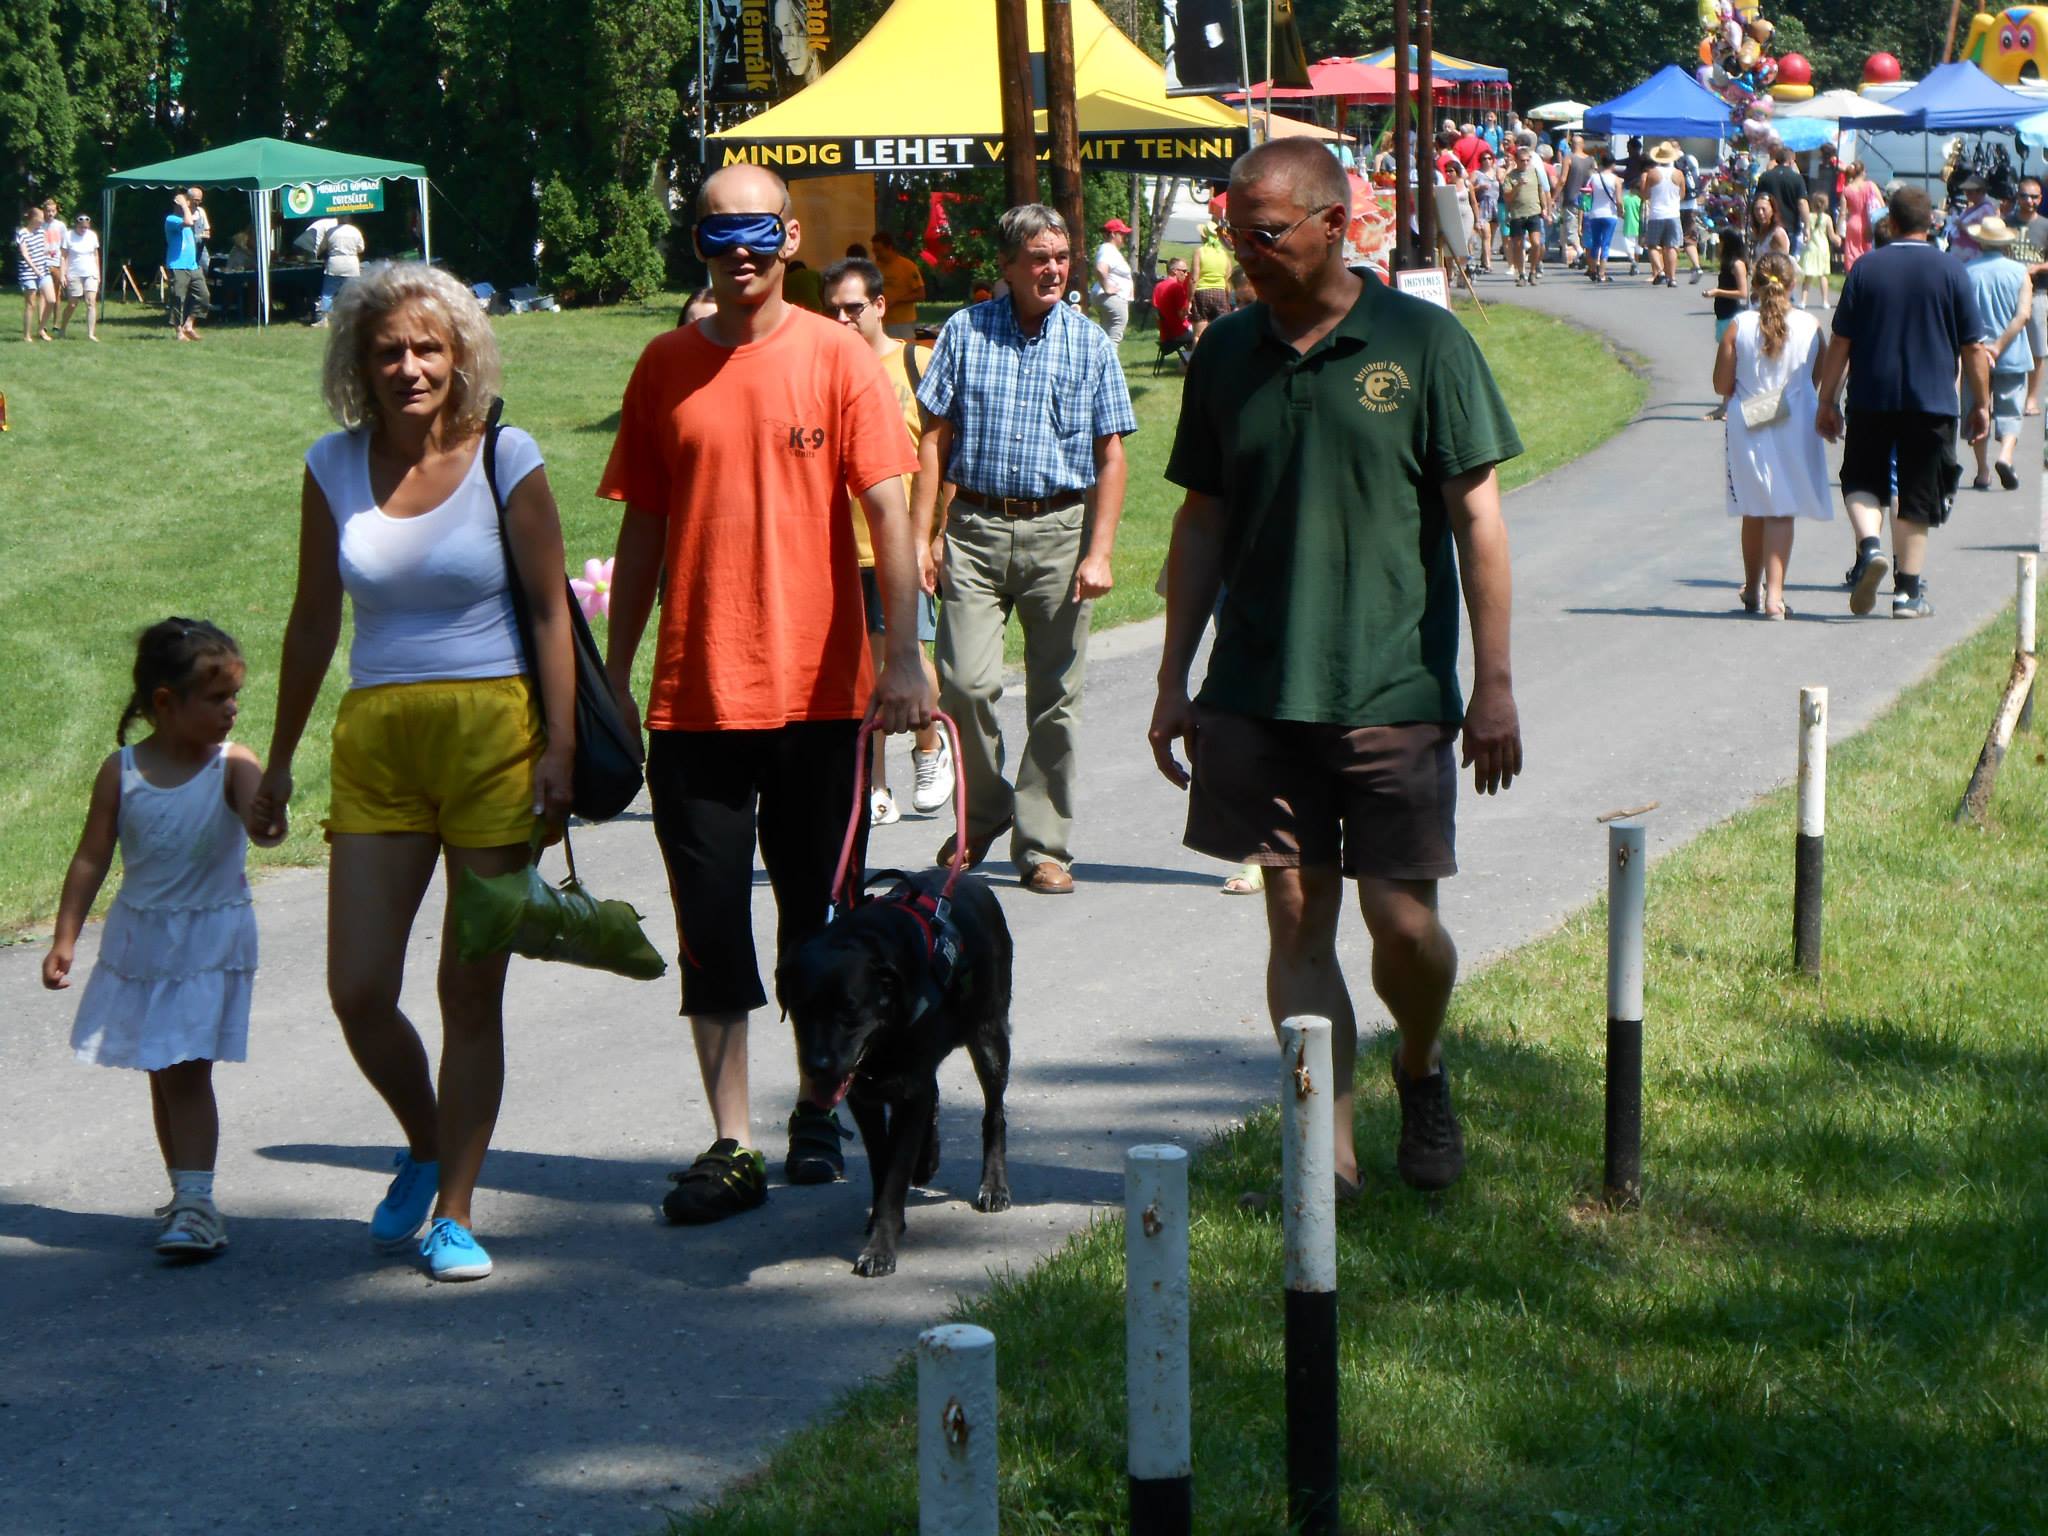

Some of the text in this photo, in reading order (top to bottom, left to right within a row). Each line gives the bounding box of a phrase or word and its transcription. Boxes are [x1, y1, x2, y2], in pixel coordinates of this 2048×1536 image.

[723, 144, 842, 167] MINDIG
[854, 138, 974, 165] LEHET
[1134, 138, 1233, 159] TENNI
[789, 427, 825, 449] K-9
